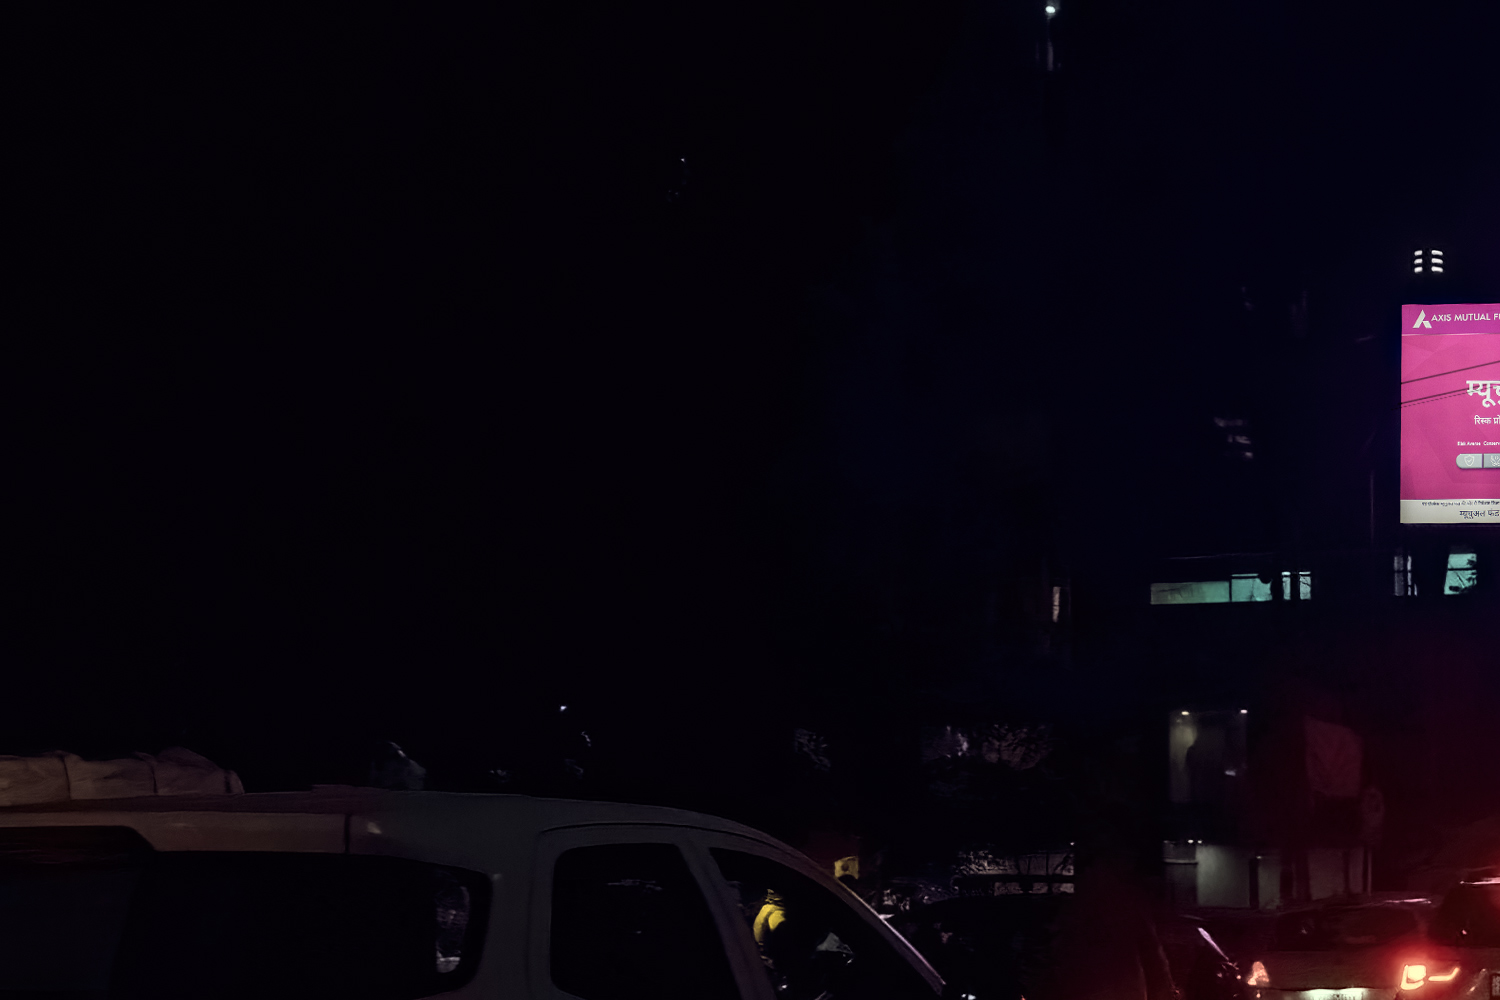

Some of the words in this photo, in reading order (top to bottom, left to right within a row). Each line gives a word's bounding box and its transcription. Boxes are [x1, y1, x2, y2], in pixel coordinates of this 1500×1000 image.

[1431, 313, 1452, 322] AXIS
[1454, 313, 1491, 322] MUTUAL
[1474, 414, 1492, 425] रिस्क
